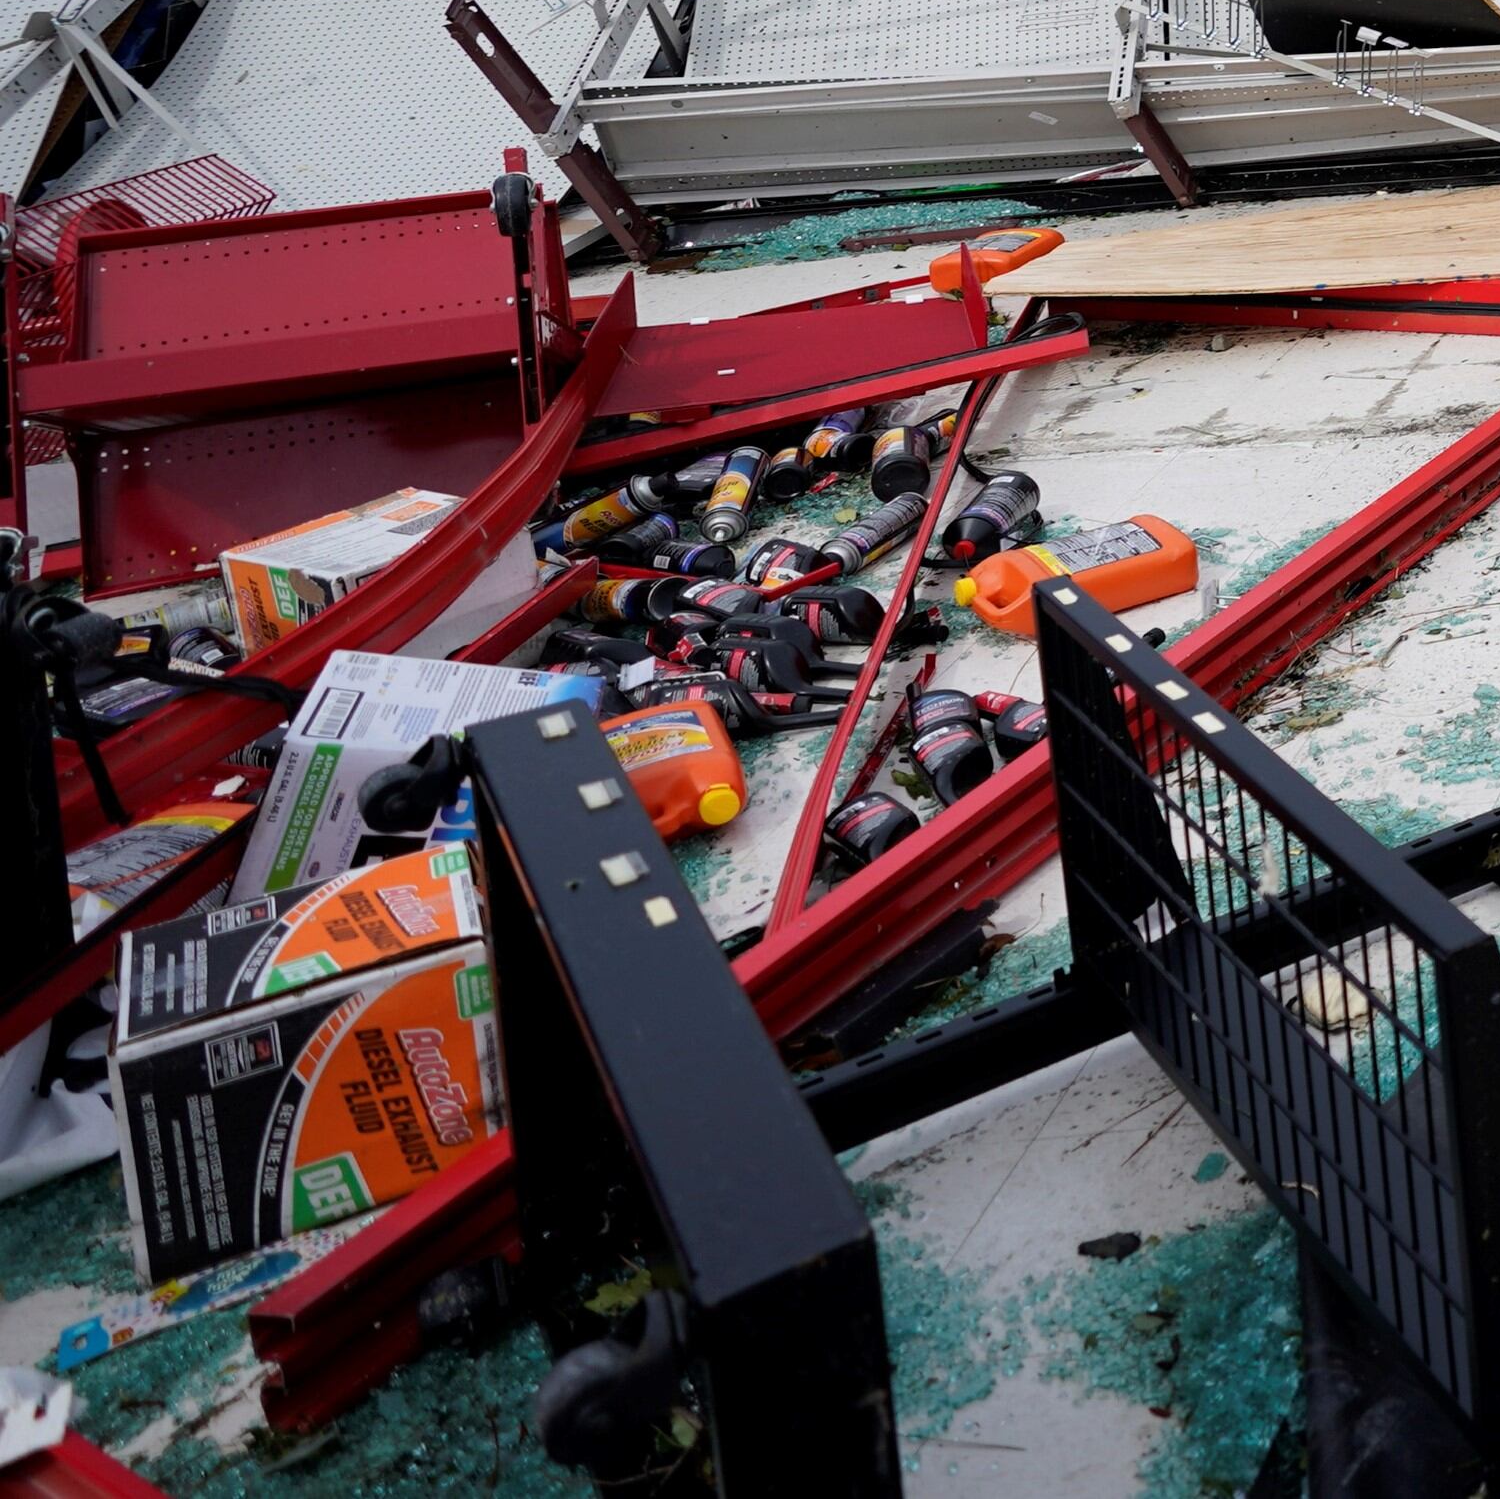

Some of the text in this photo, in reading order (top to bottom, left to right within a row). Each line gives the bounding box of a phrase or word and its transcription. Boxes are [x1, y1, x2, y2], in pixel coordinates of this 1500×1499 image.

[273, 574, 295, 616] DEF
[308, 753, 335, 806] APPROVED
[309, 752, 326, 773] ALL
[297, 773, 319, 807] DIESEL
[293, 827, 309, 847] USE
[300, 807, 316, 828] FOR
[274, 826, 300, 871] SYSTEMS
[340, 1080, 385, 1134] FLUID
[354, 1028, 440, 1175] DIESEL EXHAUST
[396, 1028, 473, 1146] AutoZone
[280, 1103, 295, 1123] GET
[268, 1142, 284, 1164] THE
[299, 1164, 358, 1221] DEF
